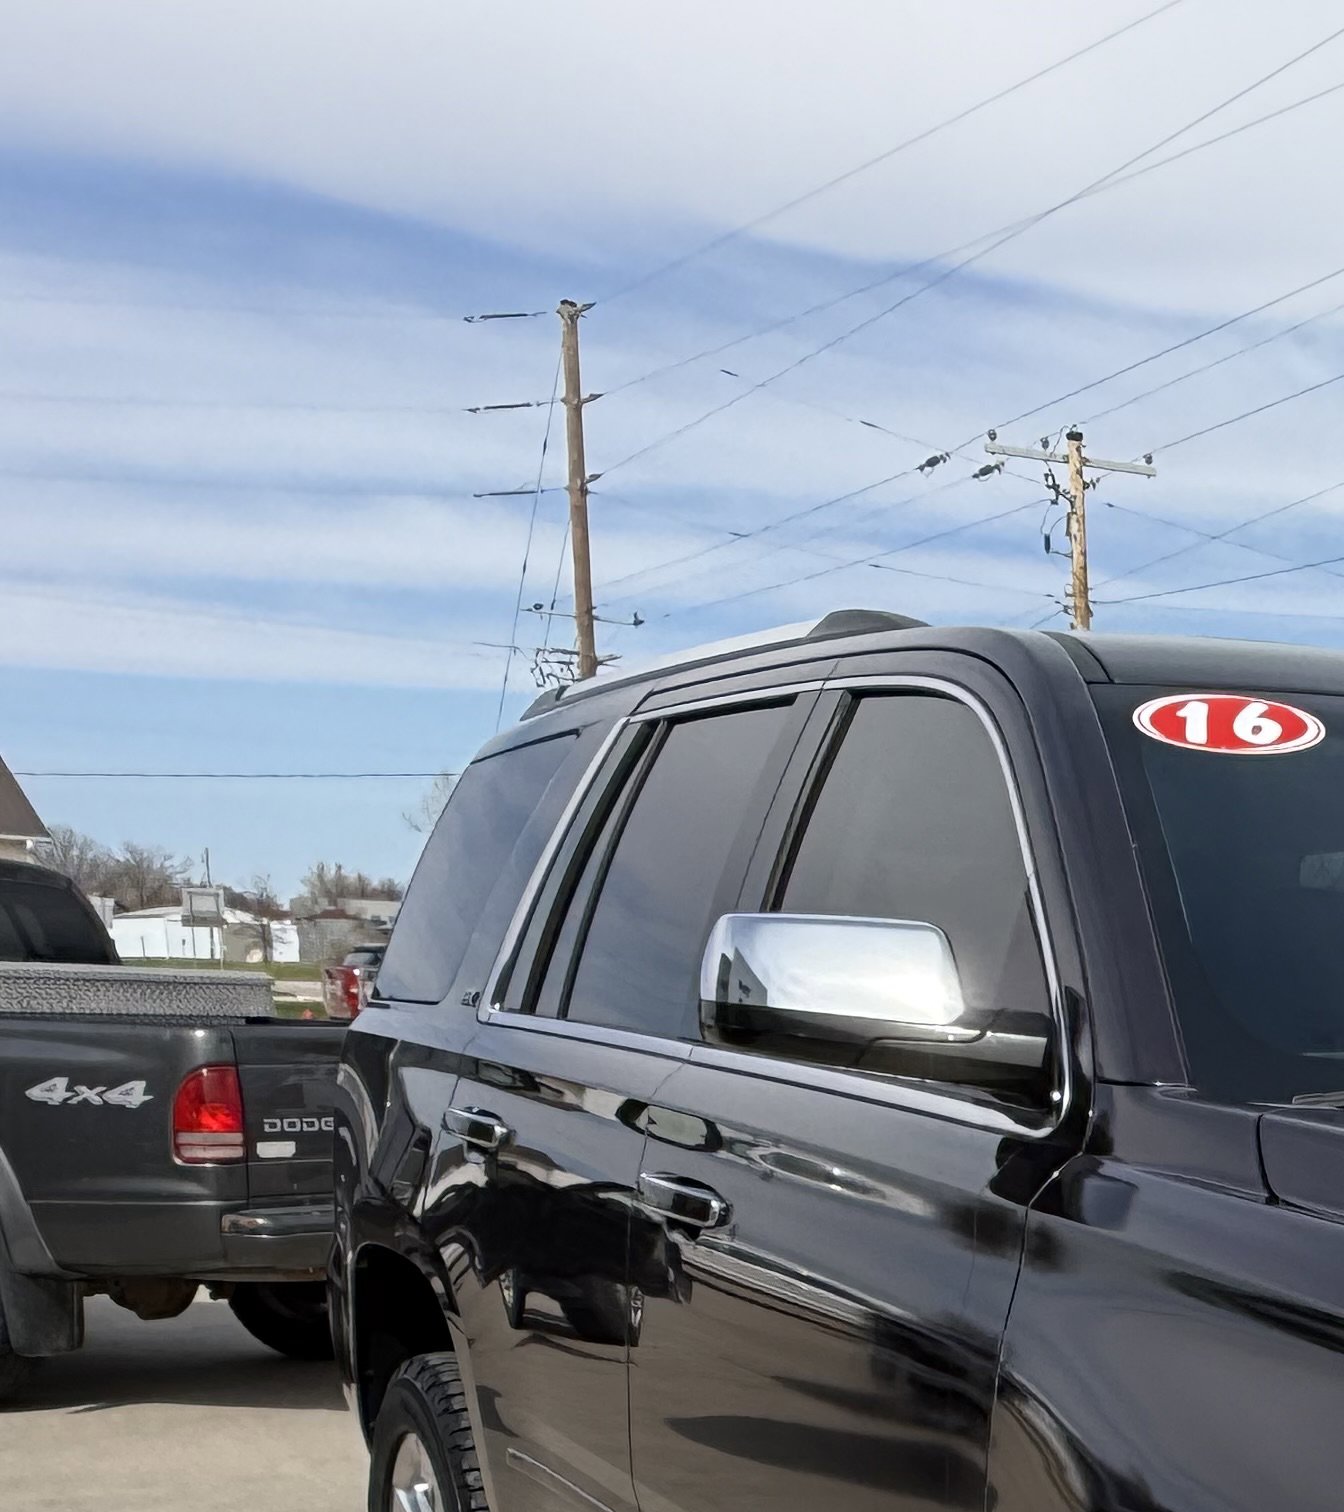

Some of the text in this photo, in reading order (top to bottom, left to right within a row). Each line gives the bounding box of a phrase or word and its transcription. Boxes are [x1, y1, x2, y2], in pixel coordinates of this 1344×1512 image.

[1176, 701, 1283, 745] 16
[25, 1077, 154, 1108] 4x4
[263, 1116, 334, 1132] DODG
